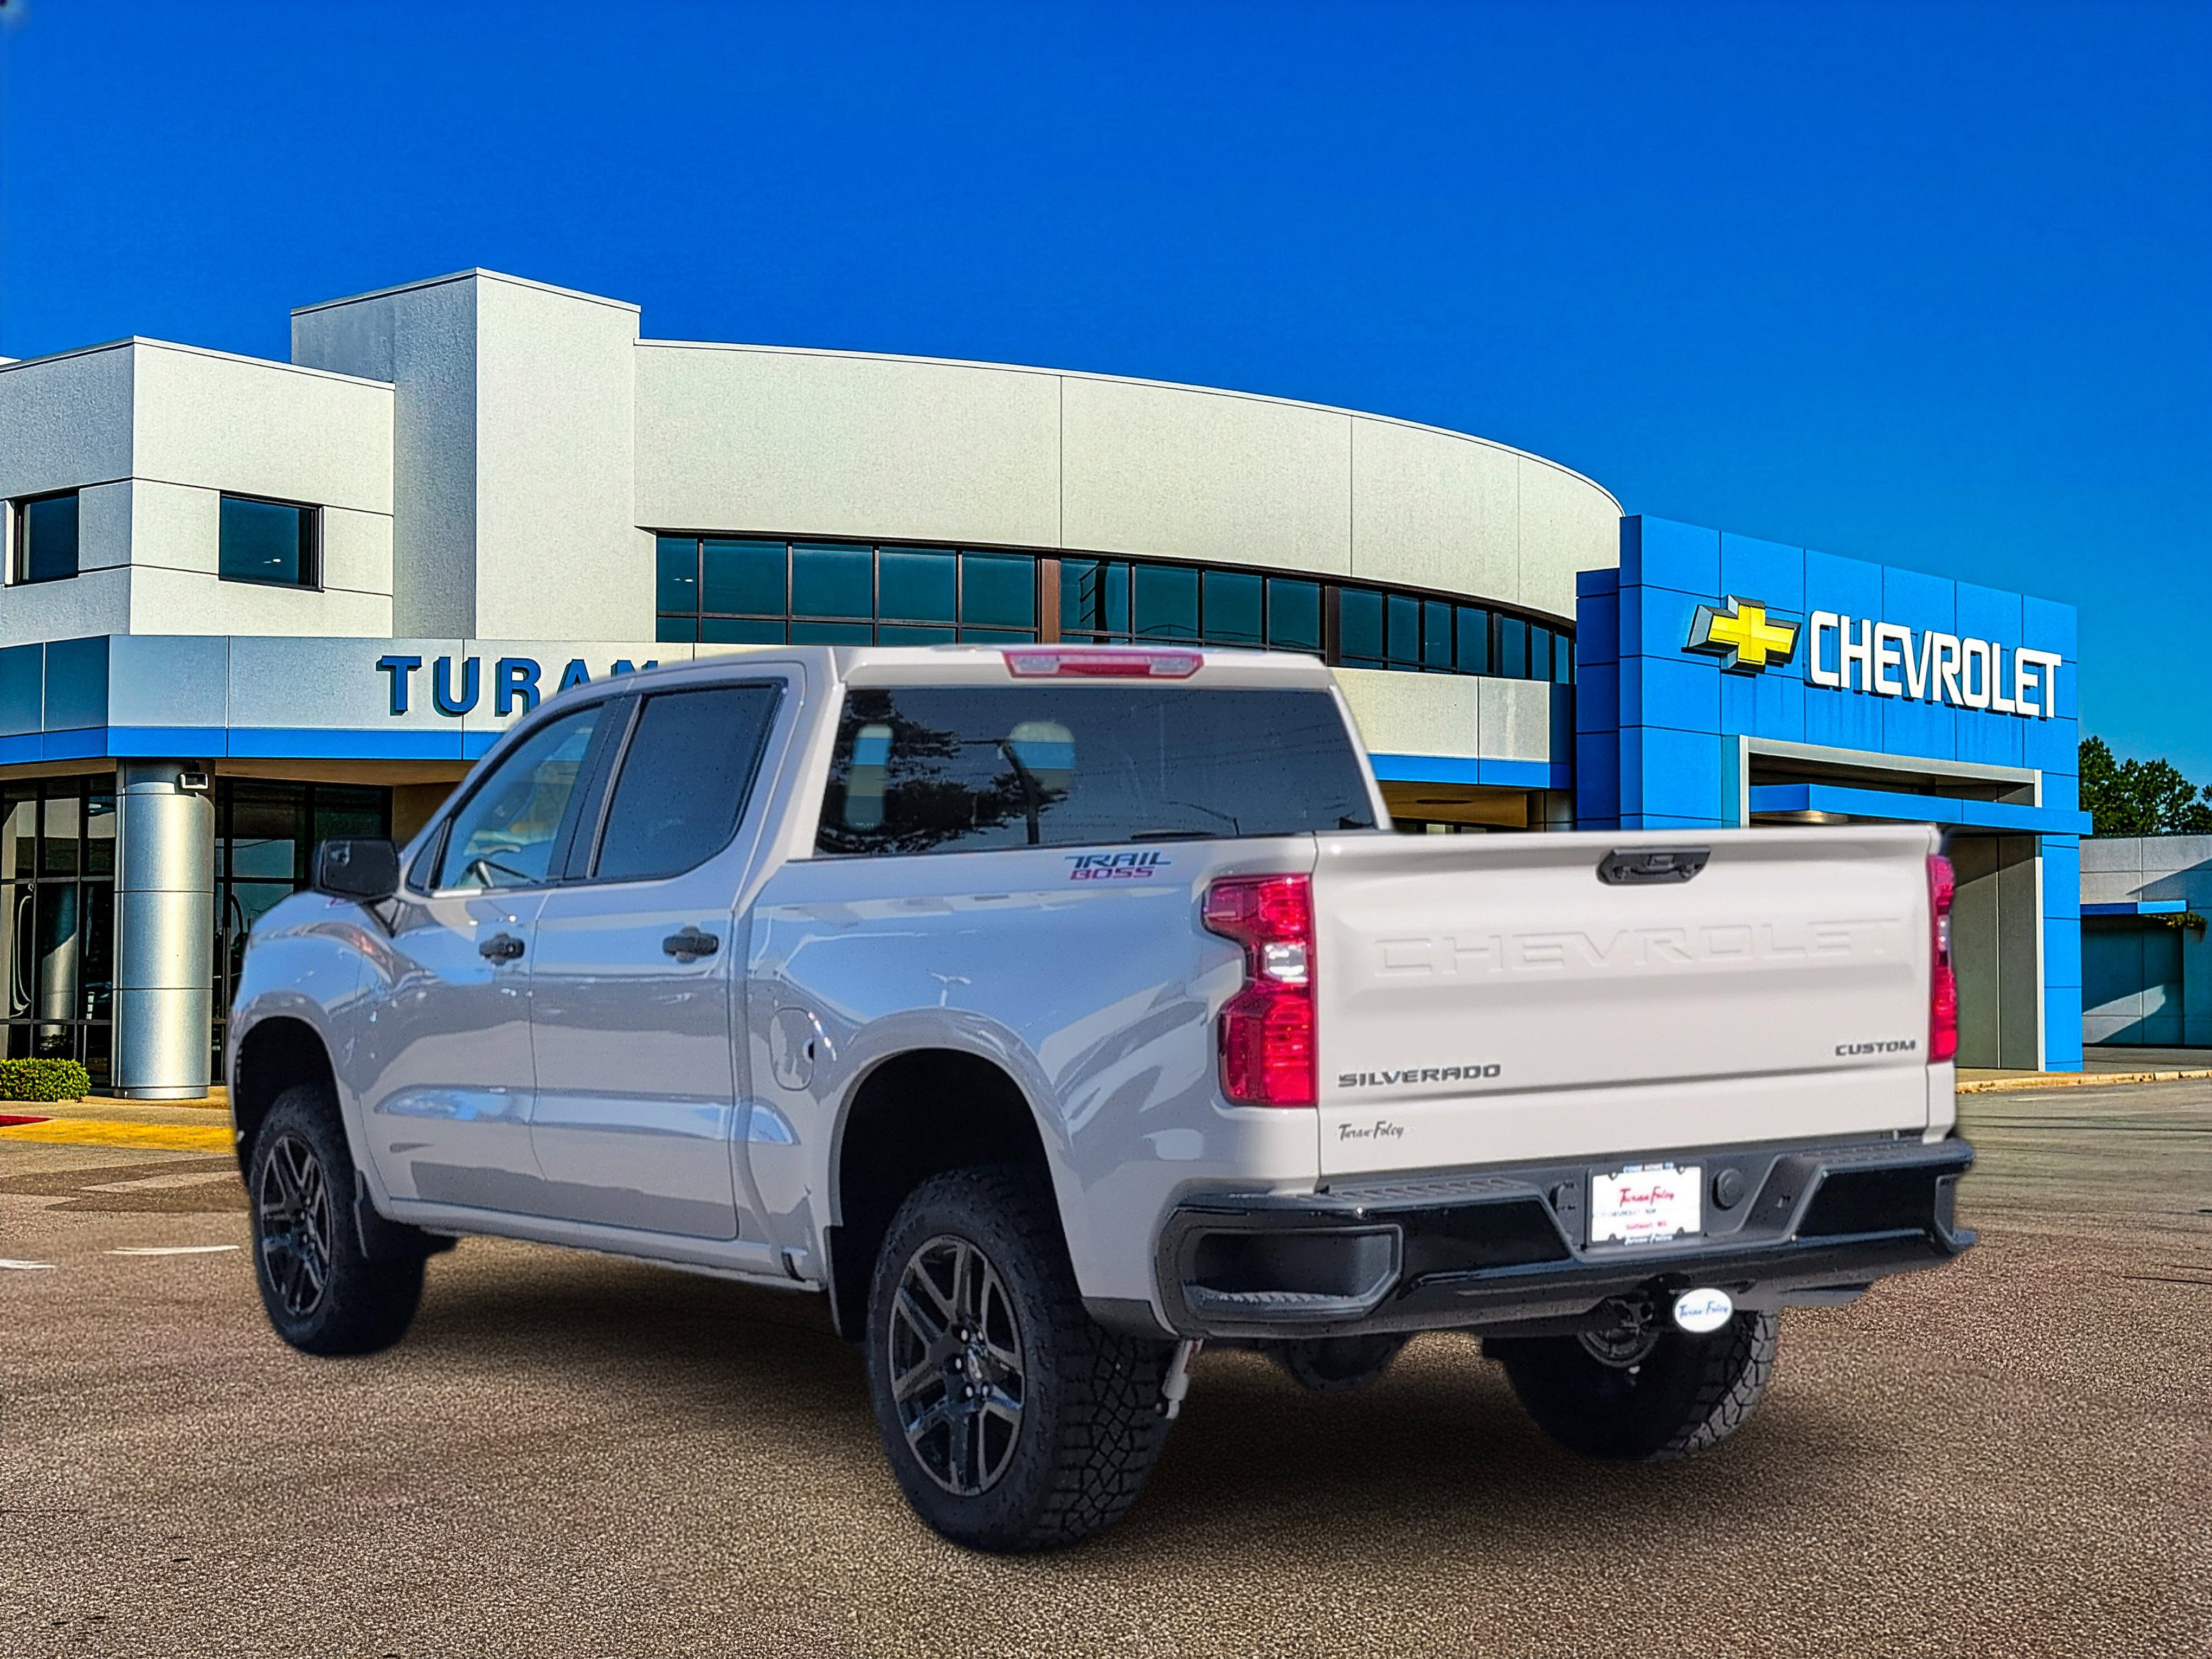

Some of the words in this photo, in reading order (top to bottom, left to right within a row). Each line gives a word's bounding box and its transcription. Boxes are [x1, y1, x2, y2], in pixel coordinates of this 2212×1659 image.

[1810, 610, 2062, 718] CHEVROLET
[376, 655, 658, 717] TURA
[1065, 852, 1172, 869] TRAIL
[1070, 866, 1155, 880] BOSS
[1374, 917, 1900, 976] CHEVROLET
[1835, 1039, 1916, 1056] CUSTOM
[1338, 1064, 1501, 1088] SILVERADO
